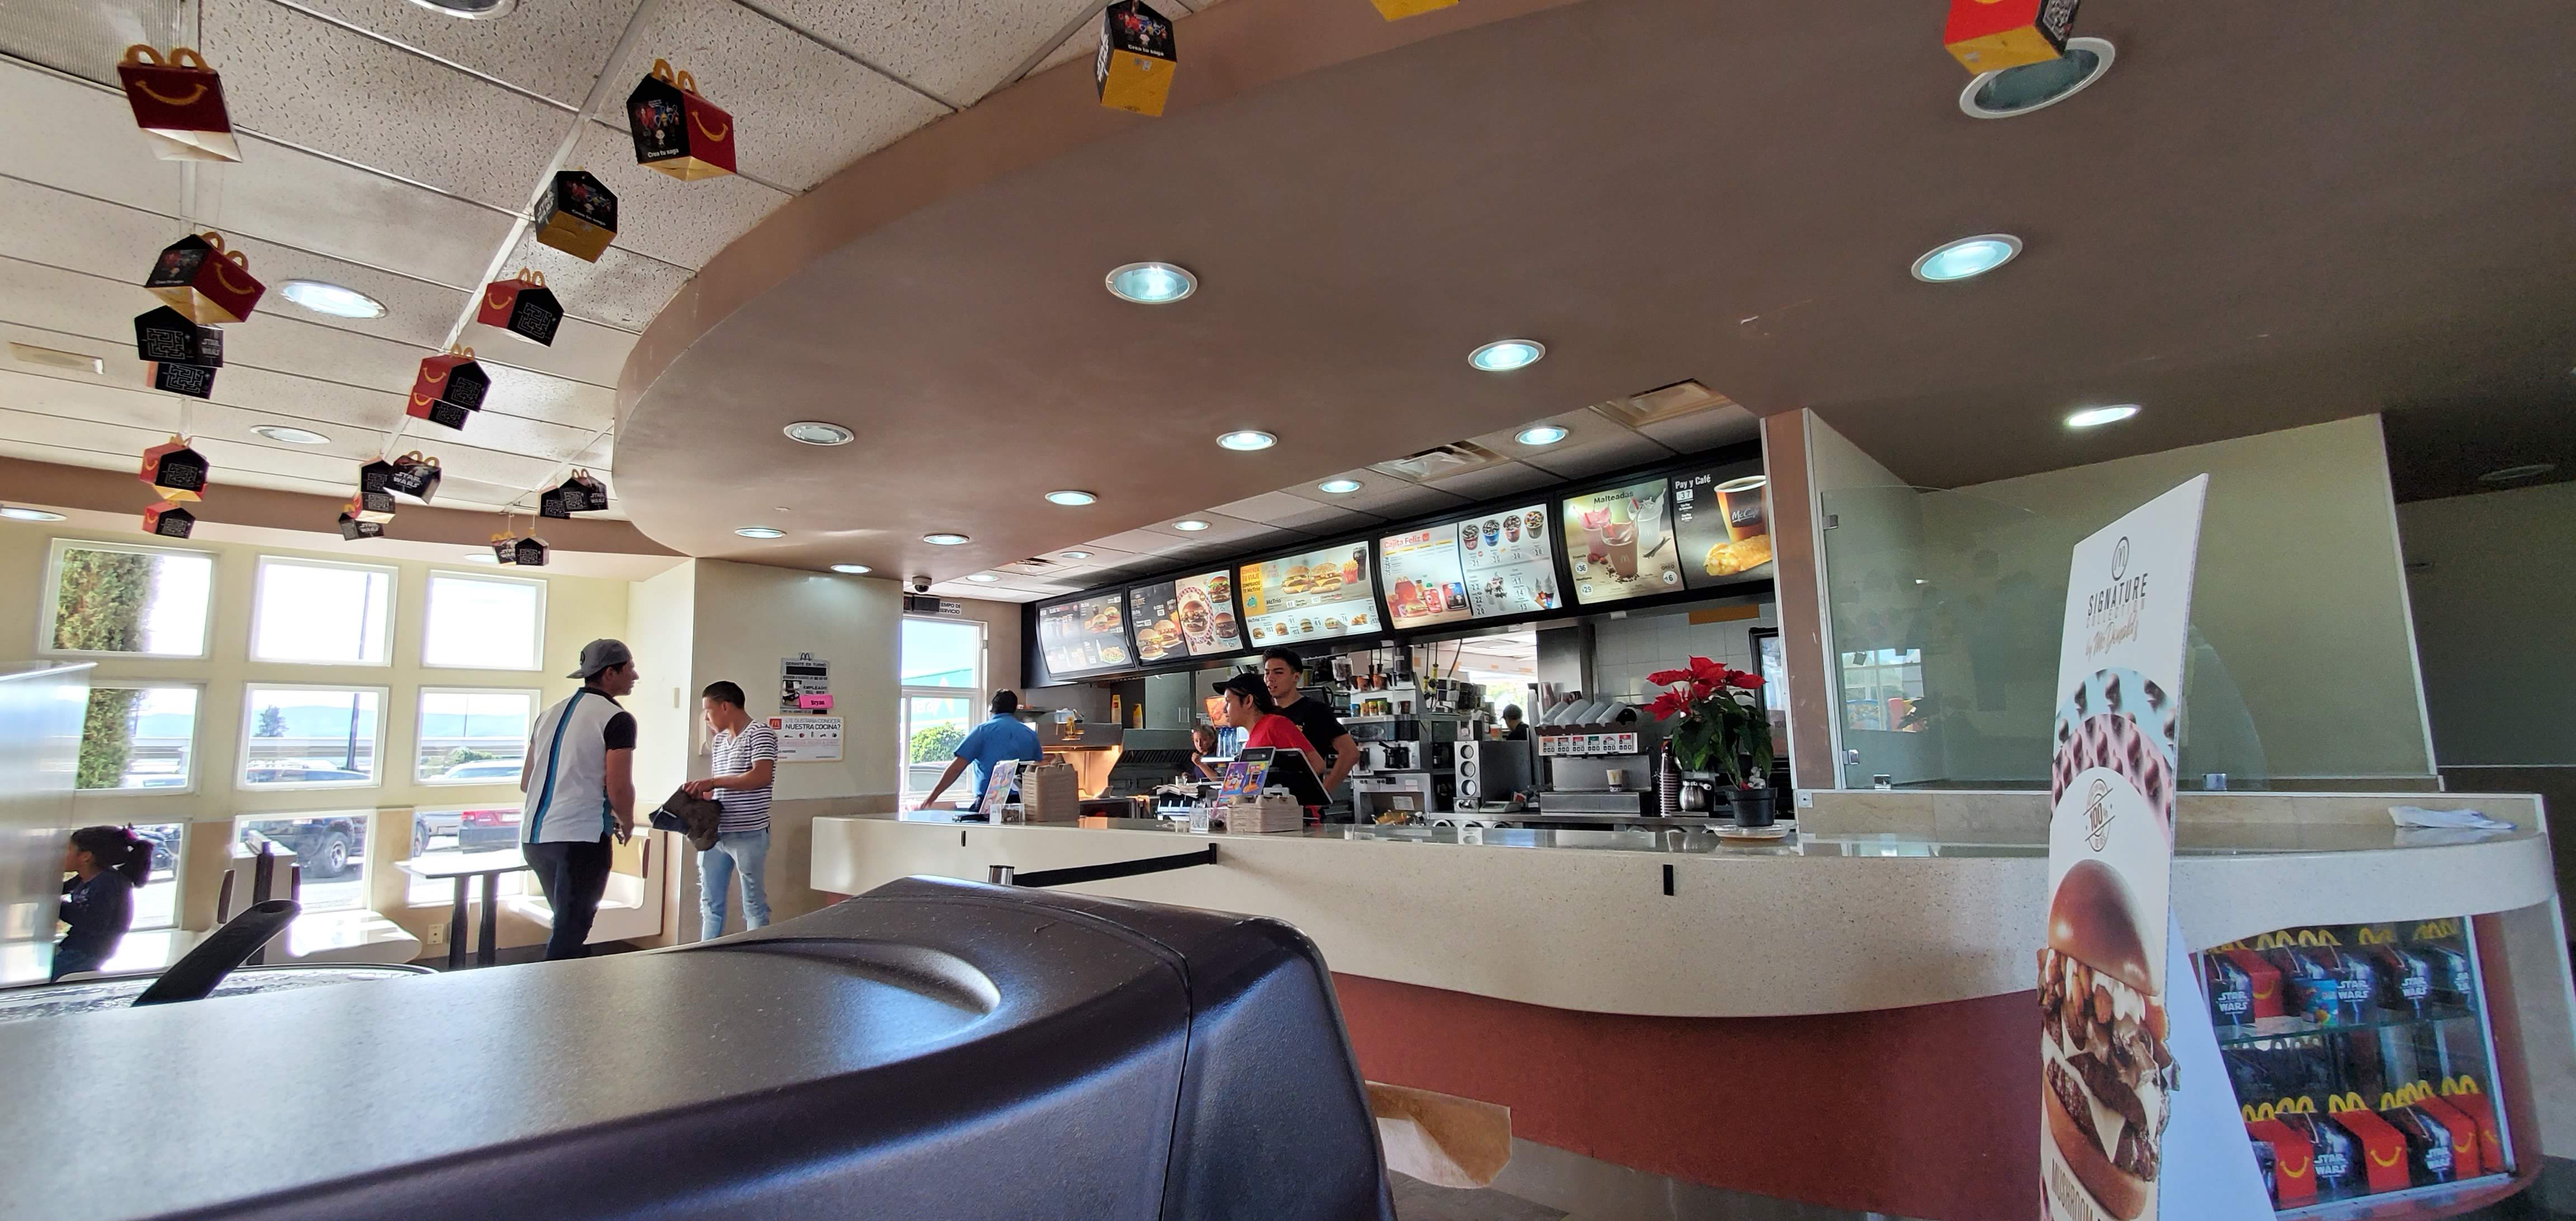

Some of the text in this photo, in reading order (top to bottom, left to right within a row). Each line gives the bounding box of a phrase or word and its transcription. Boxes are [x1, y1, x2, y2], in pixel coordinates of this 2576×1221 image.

[395, 471, 422, 482] STAR
[393, 476, 420, 488] WARS
[1675, 474, 1711, 490] Pay y Café
[1594, 491, 1634, 504] Malteadas
[1384, 536, 1421, 549] Cajita Feliz
[2088, 573, 2148, 617] SIGNATURE
[2336, 980, 2369, 989] STAR
[2402, 977, 2427, 986] STAR
[2218, 991, 2247, 1001] STAR
[2338, 990, 2370, 1000] WARS
[2402, 987, 2427, 997] WARS
[2218, 1002, 2248, 1012] WARS
[2426, 1147, 2451, 1158] STAR
[2314, 1153, 2346, 1163] STAR
[2427, 1158, 2450, 1170] WARS
[2314, 1165, 2347, 1175] WARS
